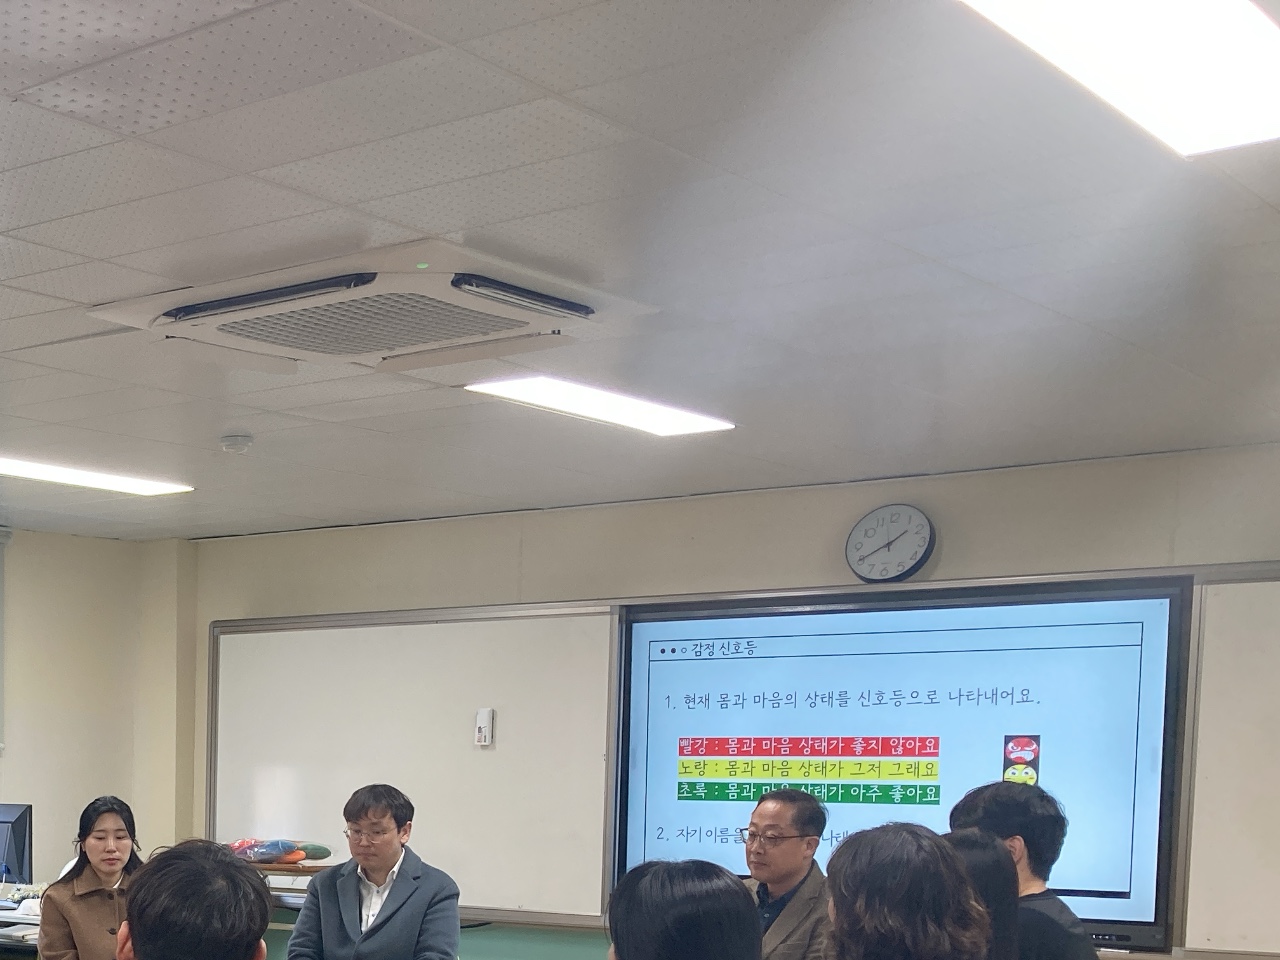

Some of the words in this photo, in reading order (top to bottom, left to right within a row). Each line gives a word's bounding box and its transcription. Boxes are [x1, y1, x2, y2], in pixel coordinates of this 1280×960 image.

[876, 517, 885, 528] 11
[890, 512, 900, 523] 12
[908, 514, 912, 525] 1
[863, 527, 876, 539] 10
[914, 523, 924, 535] 2
[854, 541, 863, 552] 9
[917, 536, 926, 548] 3
[909, 550, 918, 561] 4
[867, 563, 876, 574] 7
[880, 566, 889, 577] 6
[896, 561, 906, 573] 5
[691, 641, 715, 657] 감정
[719, 640, 757, 656] 신호등
[665, 695, 676, 709] 1.
[683, 693, 710, 710] 현재
[717, 693, 747, 709] 몸과
[753, 691, 797, 709] 마음의
[804, 690, 851, 708] 상태를
[857, 689, 941, 708] 신호등으로
[948, 687, 1041, 707] 나타내어요.
[679, 738, 708, 755] 빨강
[725, 737, 756, 755] 몸과
[762, 737, 793, 755] 마음
[798, 737, 845, 755] 상태가
[850, 737, 882, 755] 좋지
[889, 737, 939, 755] 않아요
[679, 760, 708, 777] 노랑
[725, 760, 756, 777] 몸과
[762, 760, 793, 777] 마음
[798, 760, 845, 777] 상태가
[850, 761, 882, 778] 그저
[888, 761, 938, 778] 그래요
[678, 782, 708, 799] 초록
[725, 782, 756, 800] 몸과
[850, 784, 883, 802] 아주
[889, 784, 939, 803] 좋아요
[656, 826, 669, 841] 2.
[676, 825, 701, 843] 자기
